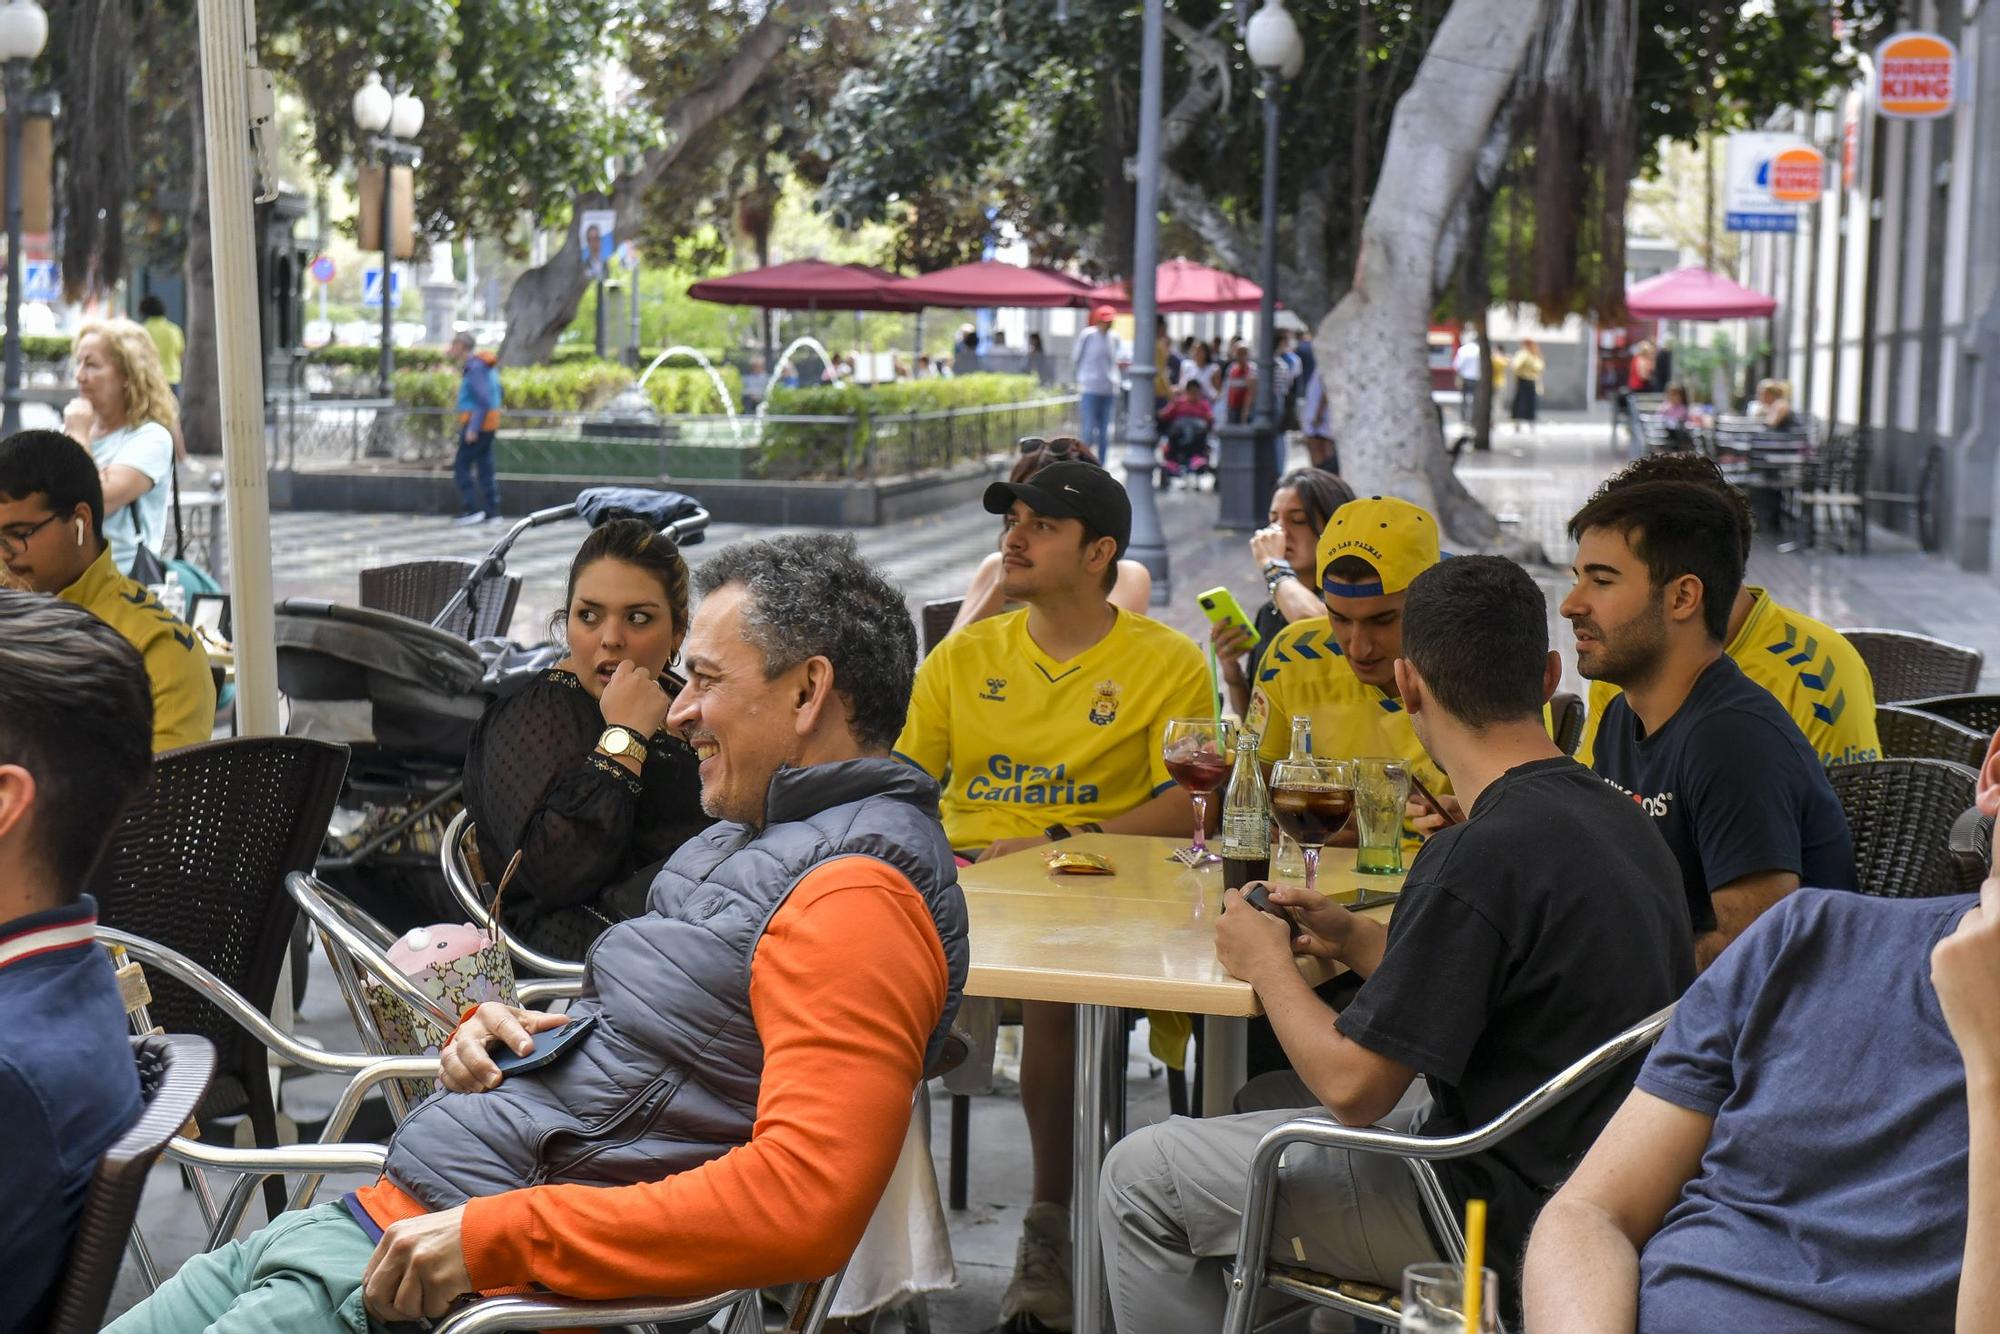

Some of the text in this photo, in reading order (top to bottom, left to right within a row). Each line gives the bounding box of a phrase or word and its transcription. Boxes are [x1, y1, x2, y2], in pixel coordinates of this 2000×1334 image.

[1881, 79, 1951, 98] KING
[1354, 541, 1382, 560] PALMAS
[967, 776, 1098, 804] Canaria
